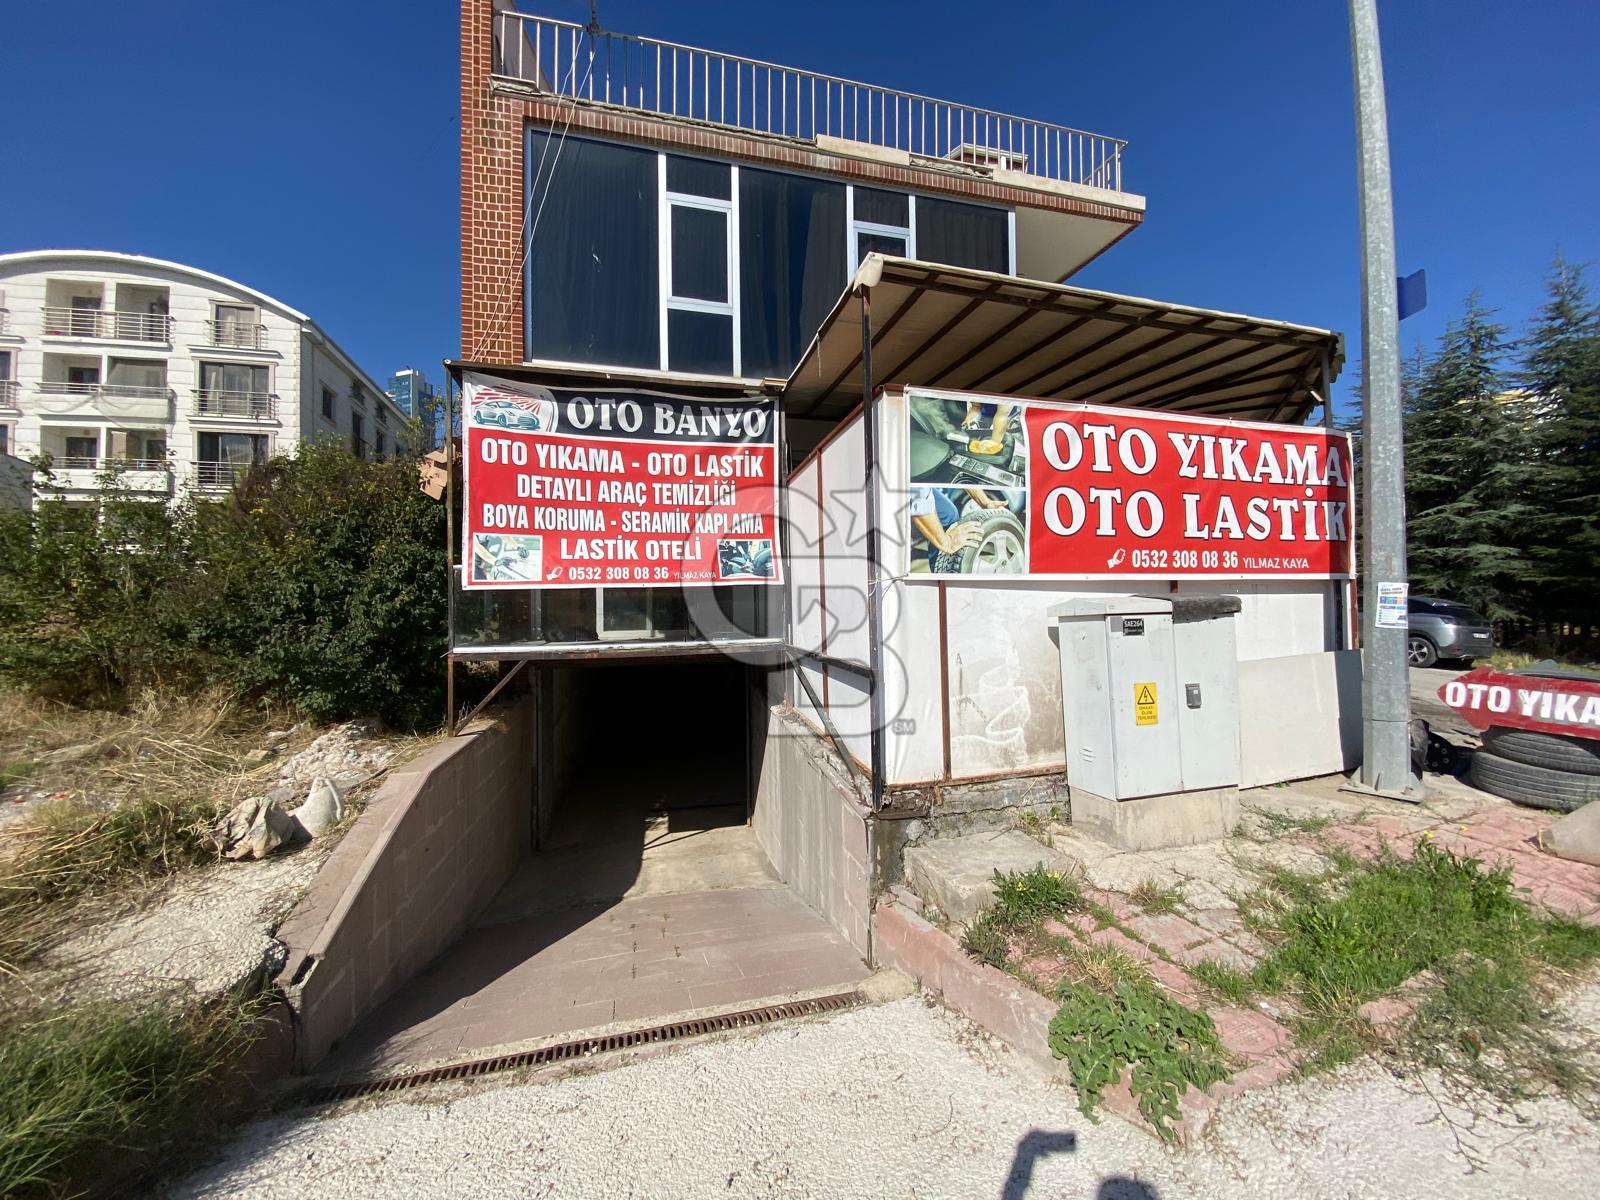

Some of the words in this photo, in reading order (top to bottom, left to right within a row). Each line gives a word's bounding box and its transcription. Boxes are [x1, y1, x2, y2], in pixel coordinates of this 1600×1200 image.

[567, 397, 643, 433] OTO
[653, 402, 770, 438] BANYO
[480, 437, 528, 466] OTO
[534, 444, 624, 473] YIKAMA
[647, 452, 687, 476] OTO
[694, 451, 764, 477] LASTİK
[1041, 422, 1157, 475] OTO
[1168, 432, 1346, 487] YIKAMA
[516, 473, 591, 501] DETAYLI
[597, 484, 647, 507] ARAÇ
[652, 479, 736, 506] TEMİZLİĞİ
[483, 503, 528, 528] BOYA
[534, 508, 605, 531] KORUMA
[621, 508, 690, 533] SERAMİK
[695, 513, 763, 534] KAPLAMA
[1042, 486, 1164, 538] OTO
[1183, 488, 1347, 542] LASTİK
[560, 535, 639, 560] LASTİK
[646, 537, 701, 560] OTELİ
[1132, 550, 1167, 568] 0532
[1172, 550, 1198, 568] 308
[1201, 550, 1219, 568] 08
[1222, 550, 1238, 568] 36
[1243, 557, 1280, 568] YILMAZ
[1282, 558, 1309, 569] KAYA
[569, 567, 601, 580] 0532
[606, 567, 630, 580] 308
[634, 567, 649, 579] 08
[654, 567, 669, 579] 36
[673, 571, 698, 579] YILMAZ
[700, 571, 716, 579] KAYA
[1446, 682, 1511, 713] OTO
